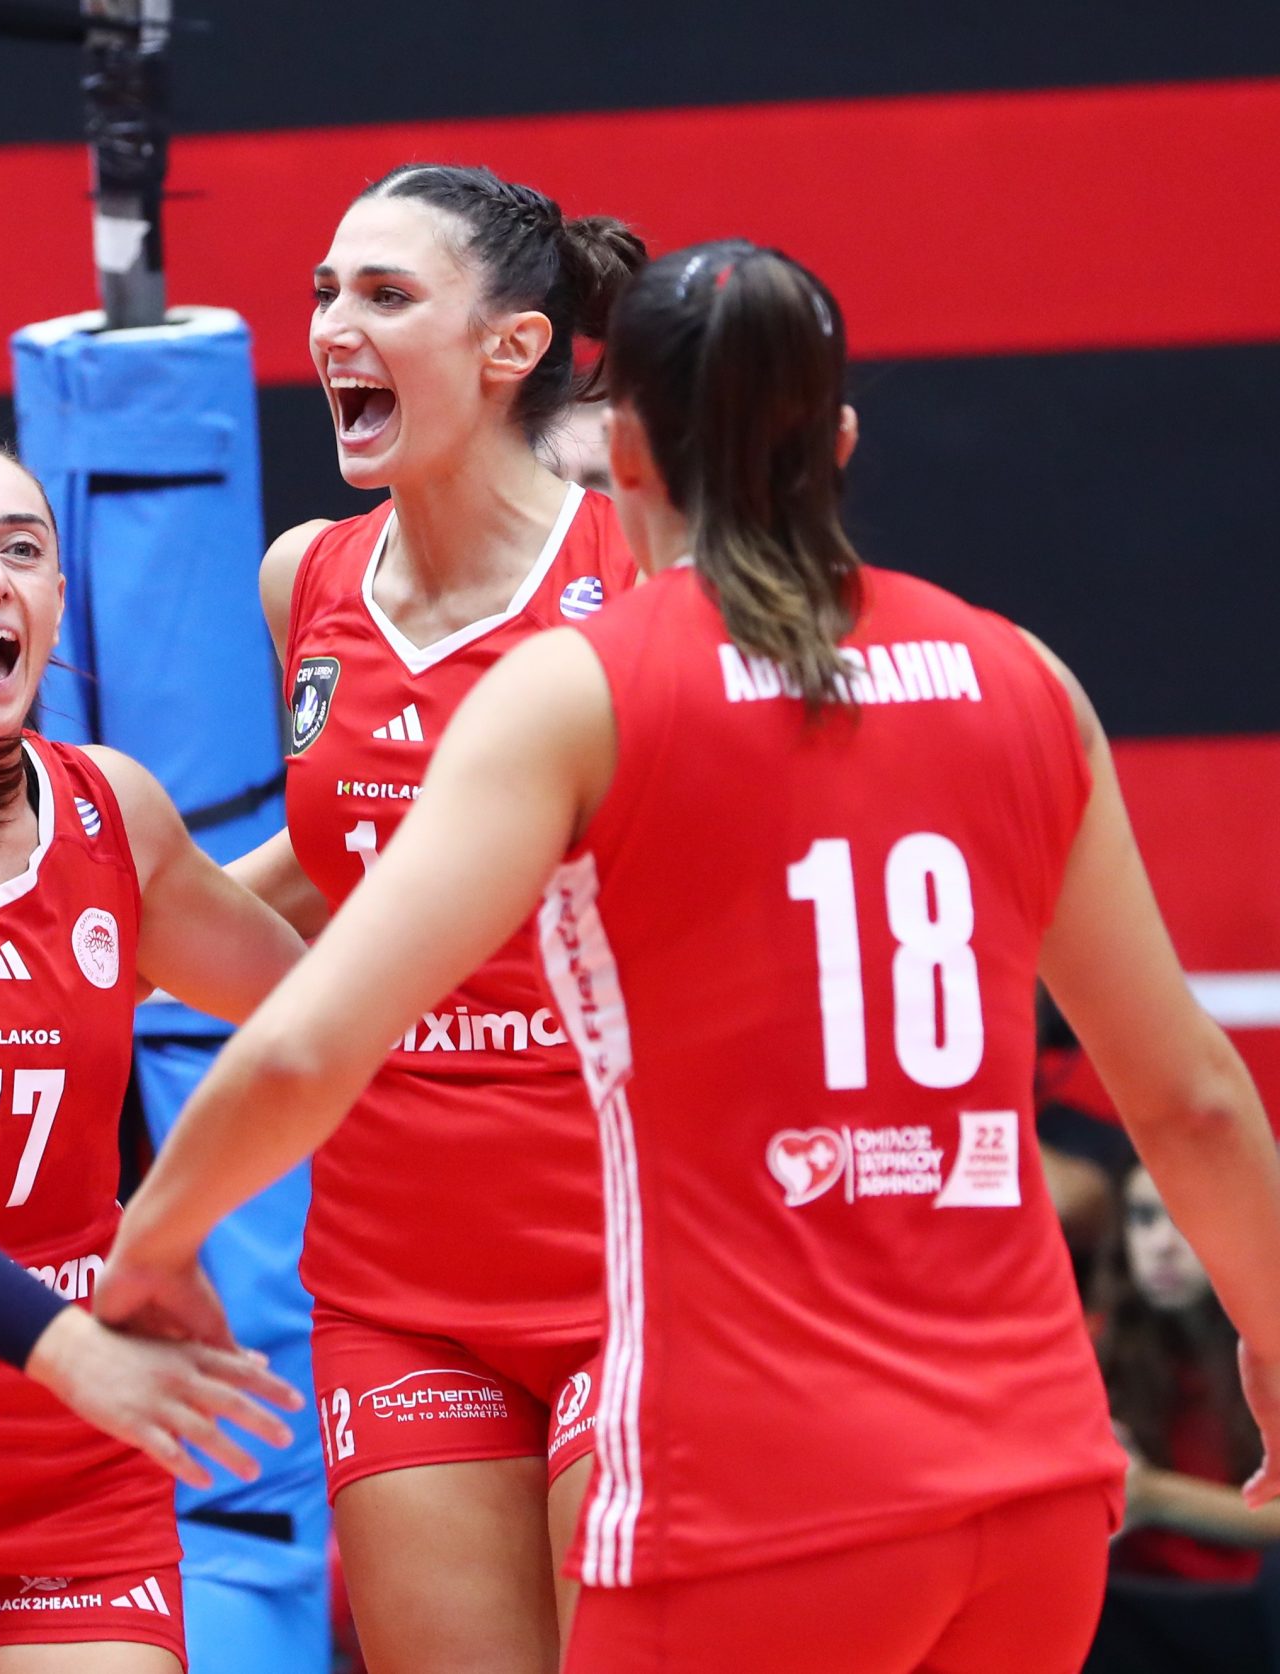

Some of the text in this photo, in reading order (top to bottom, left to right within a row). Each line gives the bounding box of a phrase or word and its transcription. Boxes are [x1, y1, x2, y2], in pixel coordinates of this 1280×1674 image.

[297, 667, 314, 683] CEV
[718, 640, 982, 704] ABRAHIM
[353, 782, 424, 800] KOILAK
[787, 832, 984, 1090] 18
[975, 1127, 1005, 1149] 22
[373, 1387, 504, 1409] buythemile
[449, 1403, 506, 1411] ΑΣΦΑΛΙΣΗ
